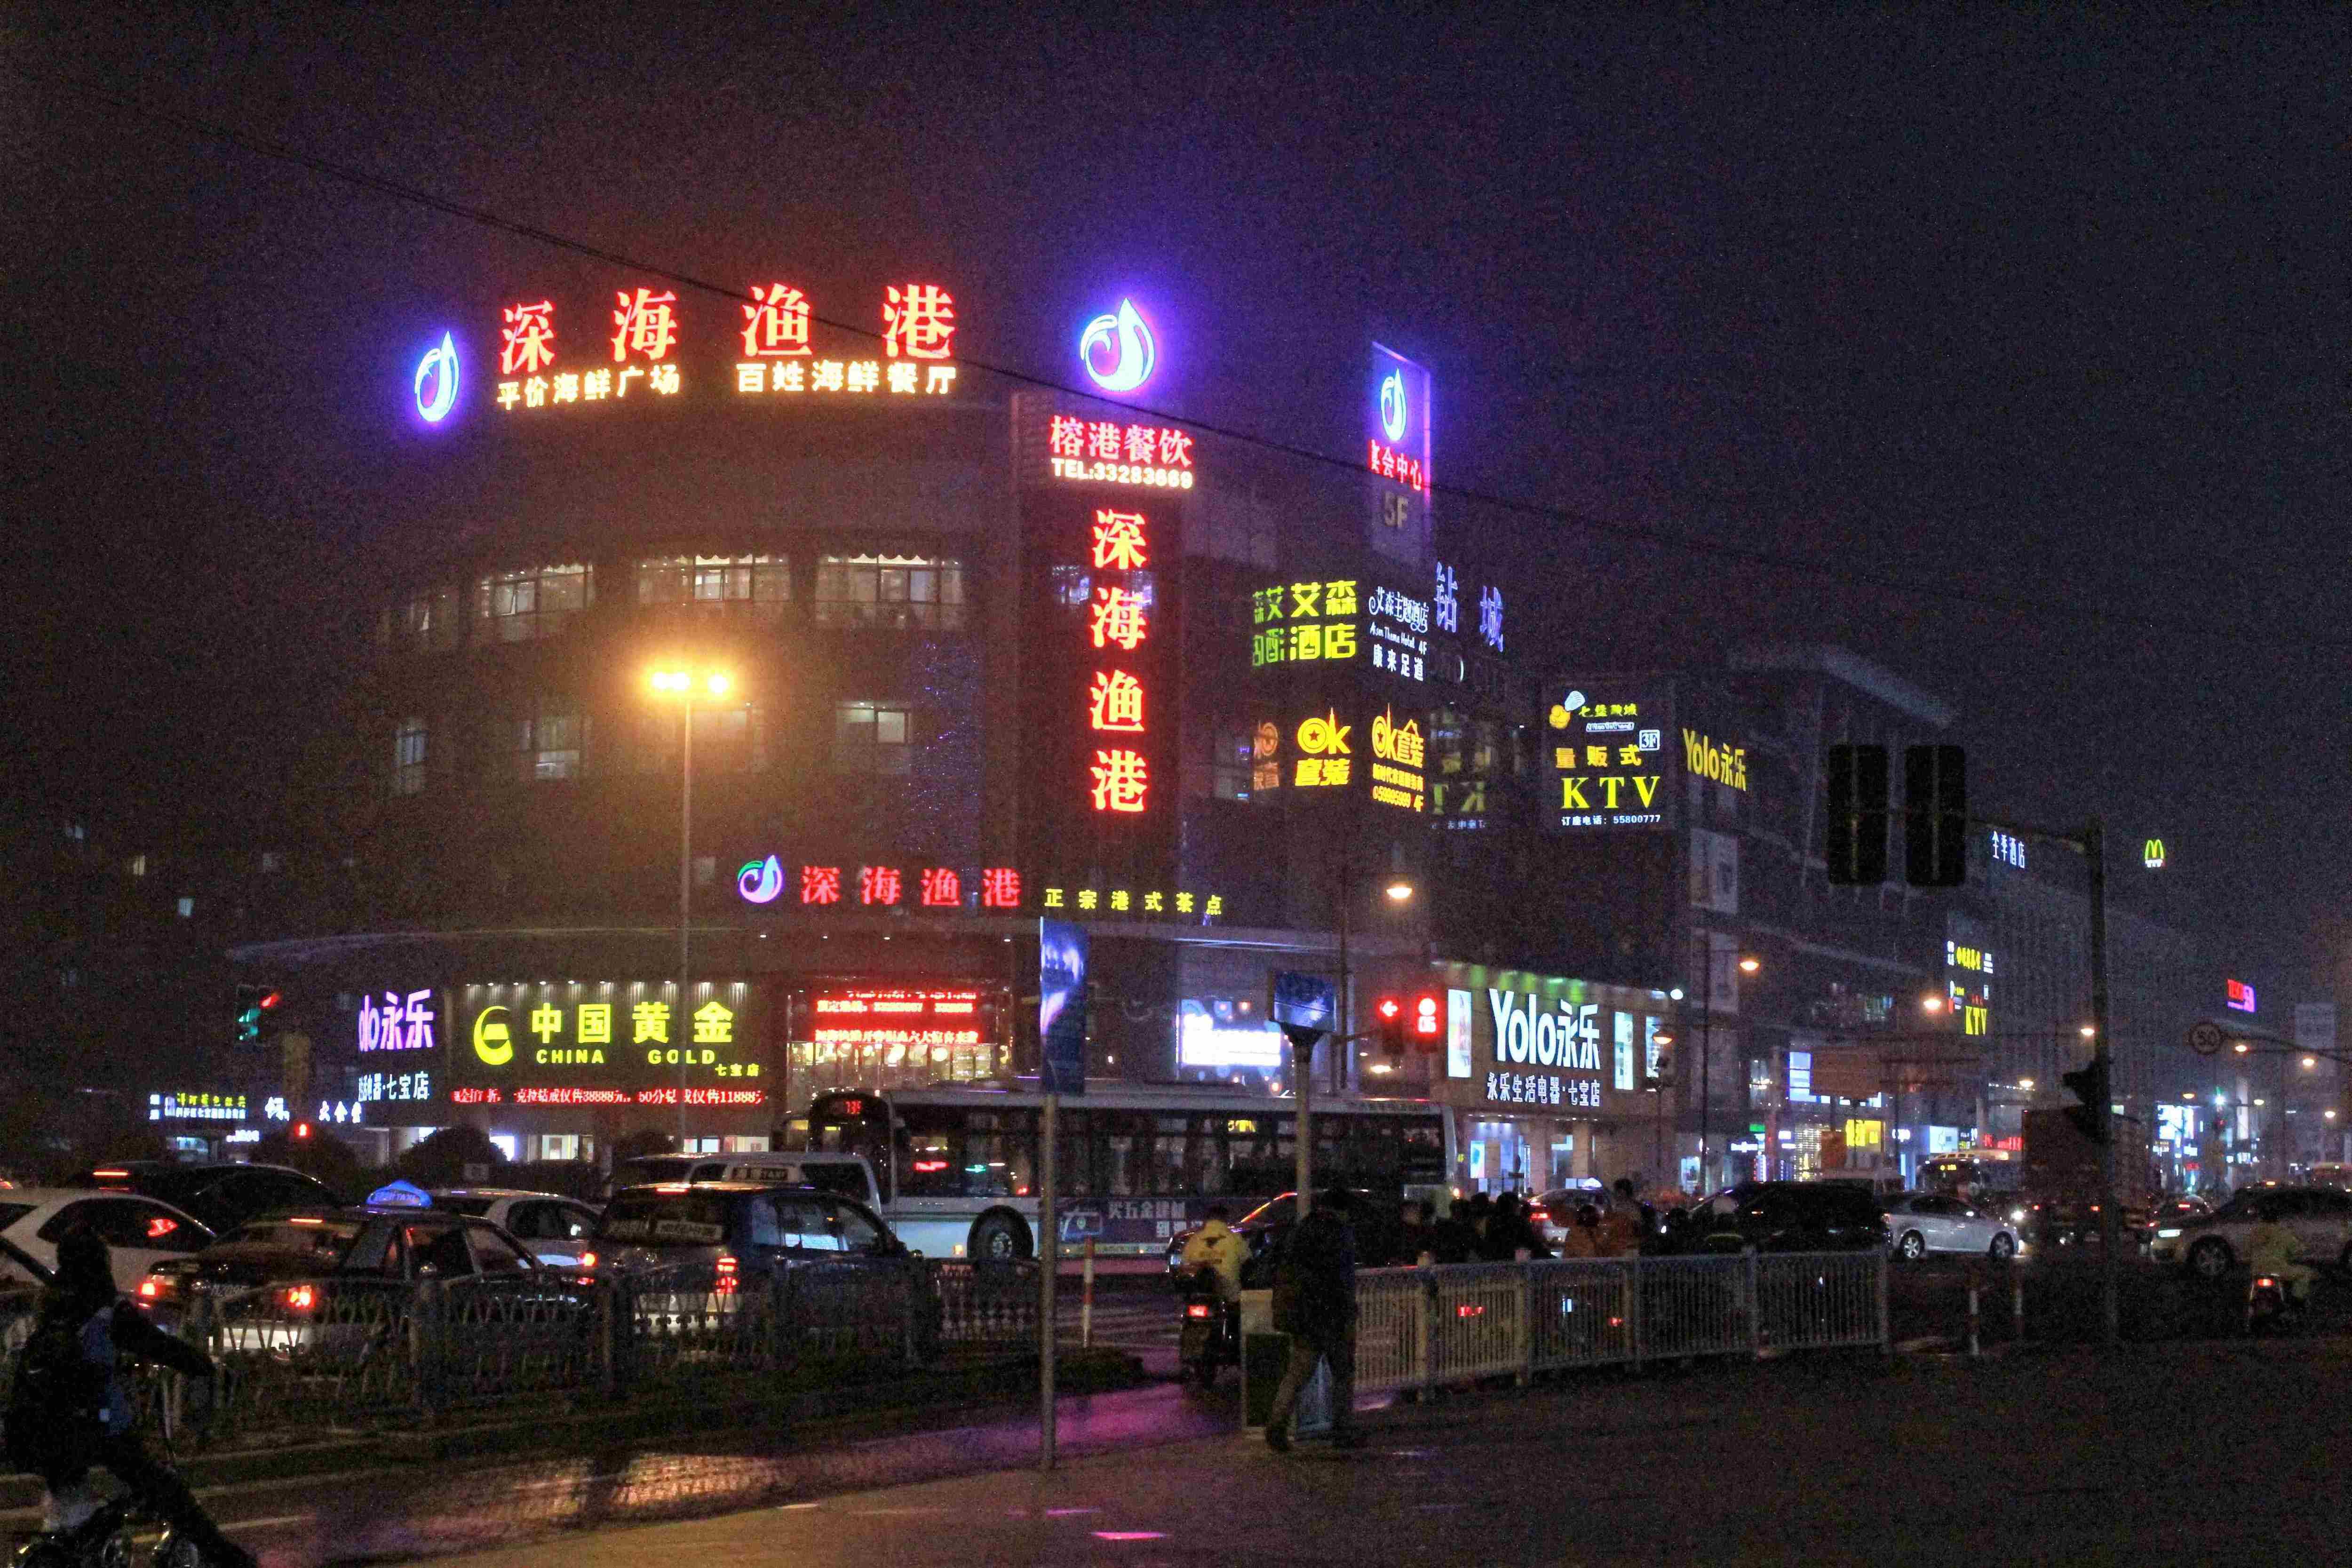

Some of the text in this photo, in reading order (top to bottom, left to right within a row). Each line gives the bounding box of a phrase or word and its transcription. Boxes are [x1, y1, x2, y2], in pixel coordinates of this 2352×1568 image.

[501, 282, 957, 374] 深海渔港
[498, 360, 956, 409] 平价海鲜广场 百姓海鲜餐厅
[1049, 415, 1193, 468] 榕港餐饮
[1290, 580, 1357, 618] 艾森
[1090, 509, 1147, 812] 深海渔港
[1290, 623, 1357, 661] 酒店
[1295, 758, 1351, 787] 套装
[1556, 744, 1642, 769] 量贩式
[1561, 776, 1661, 809] KTV
[1613, 814, 1661, 824] 55800777
[801, 865, 1022, 907] 深海渔港
[1044, 888, 1223, 915] 正宗港式茶点
[532, 1000, 734, 1044] 中国黄金
[1965, 1005, 1987, 1035] KTV
[536, 1049, 716, 1065] CHINA GOLD
